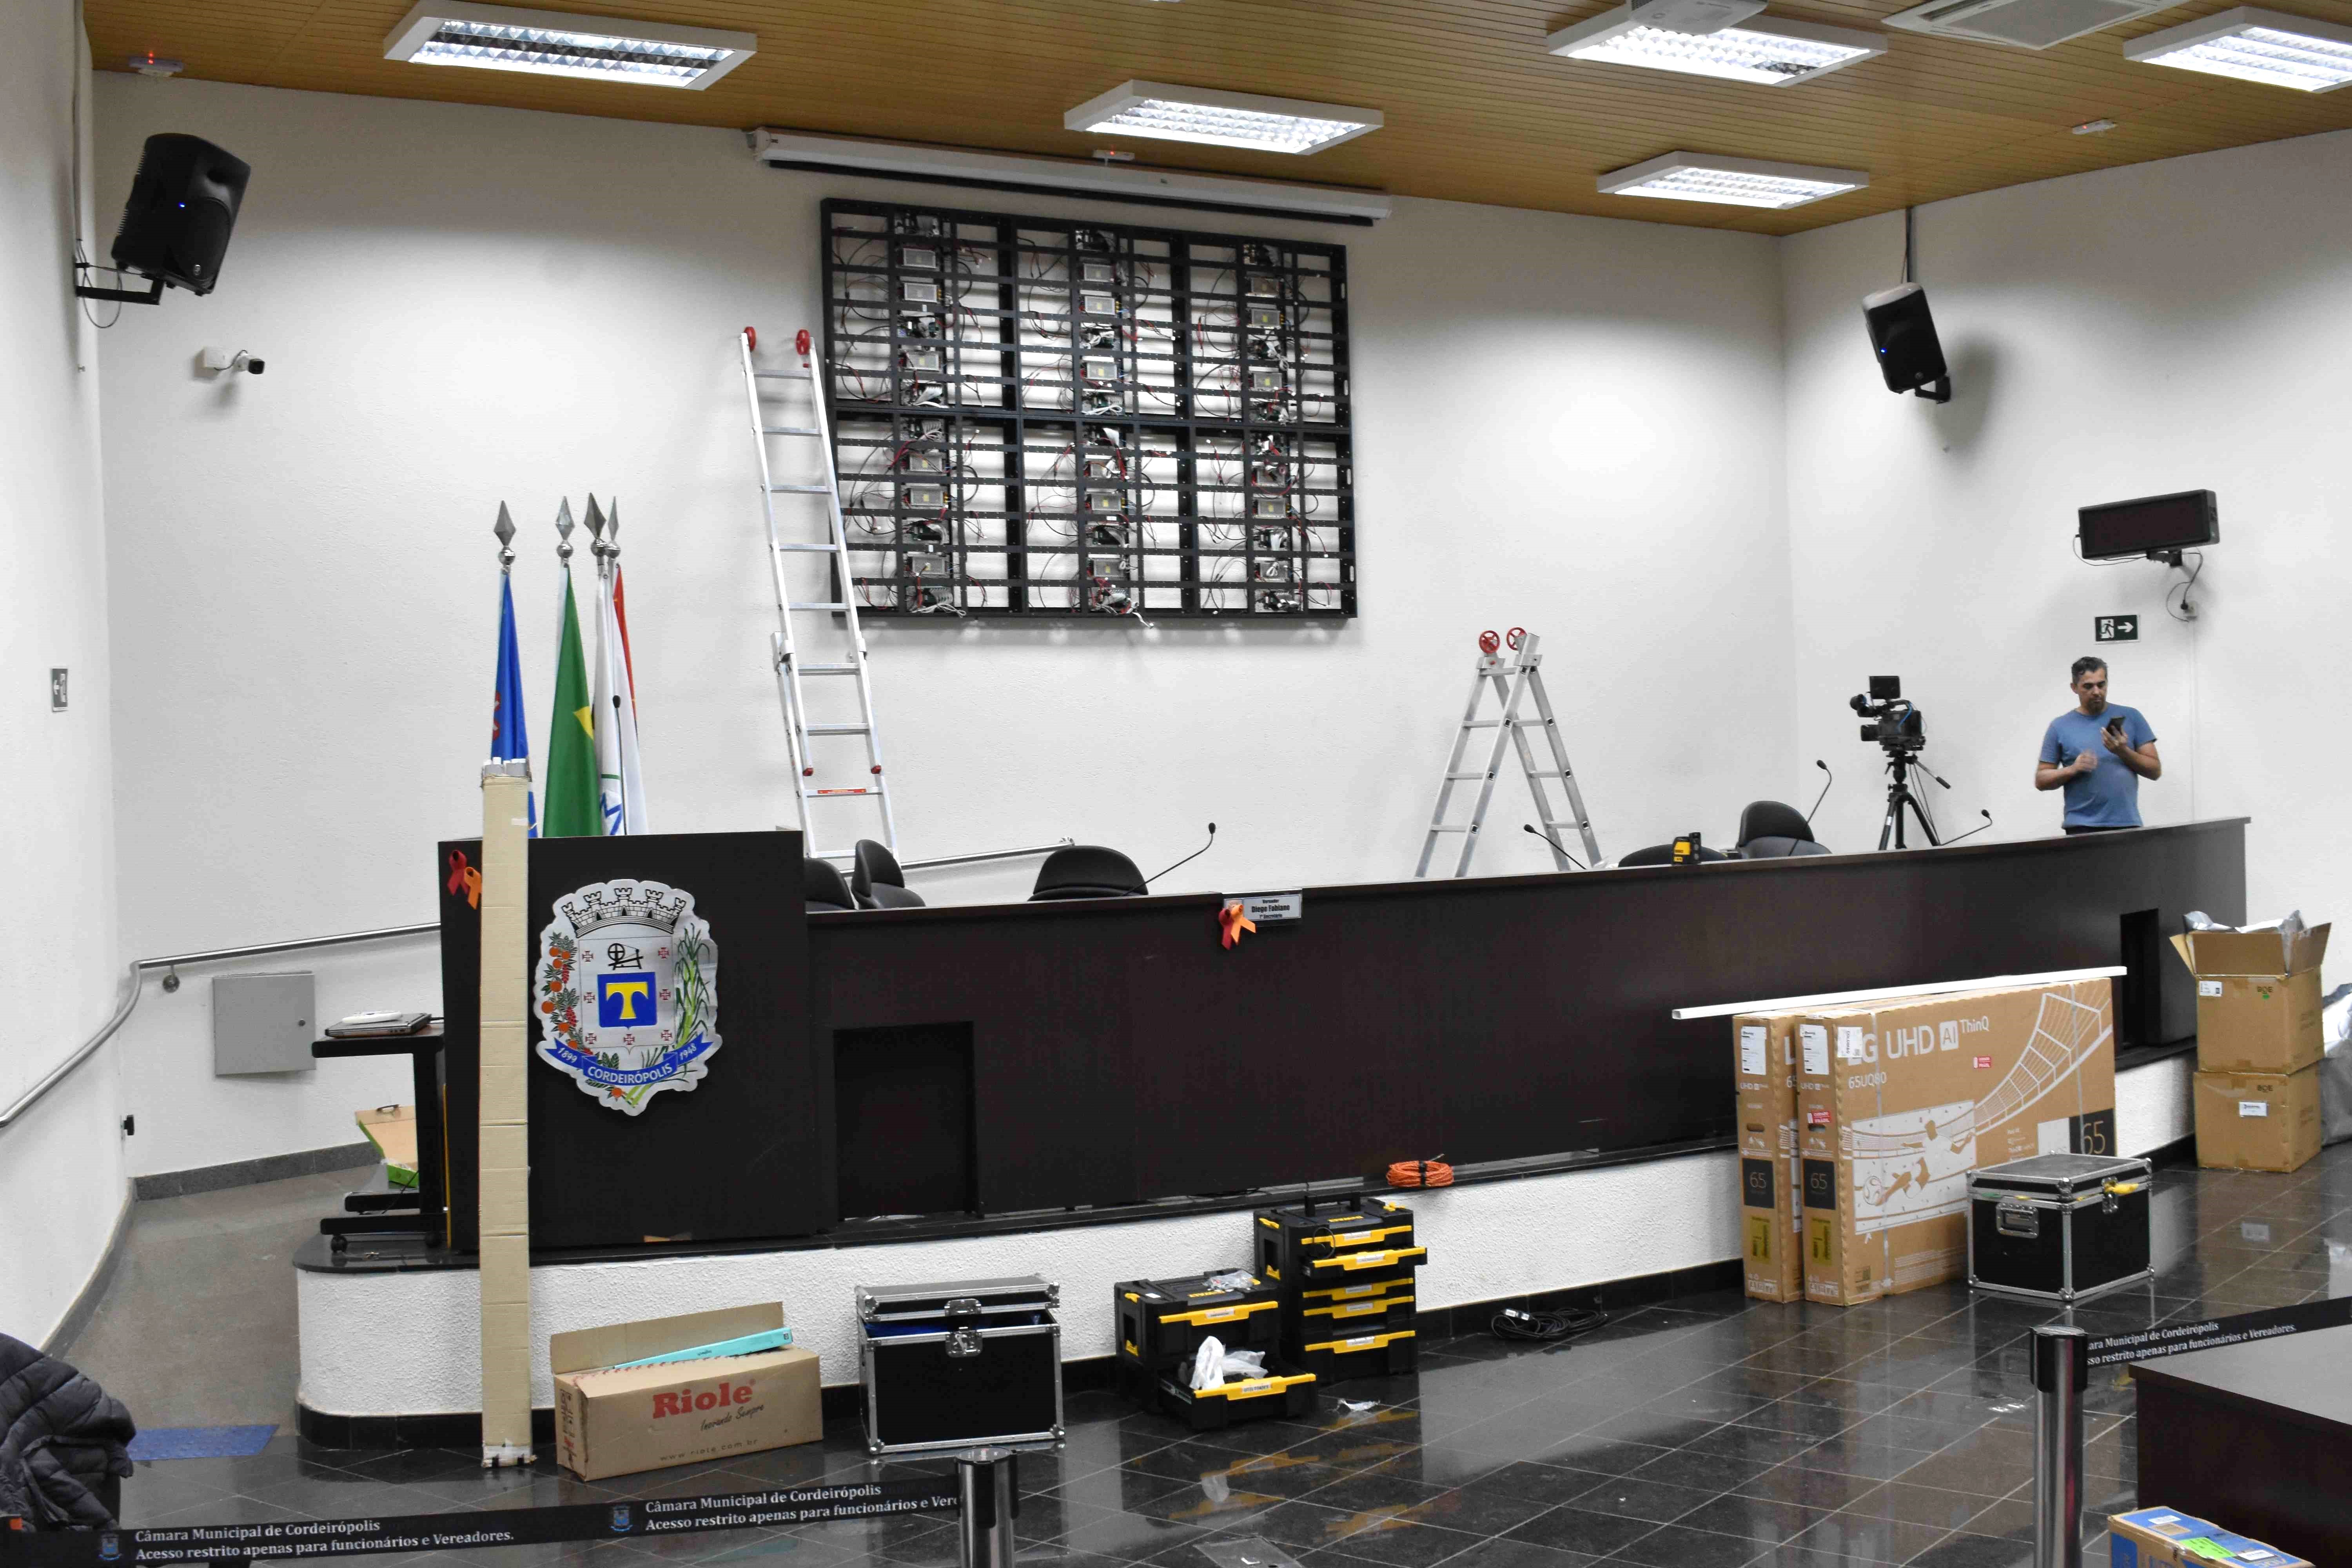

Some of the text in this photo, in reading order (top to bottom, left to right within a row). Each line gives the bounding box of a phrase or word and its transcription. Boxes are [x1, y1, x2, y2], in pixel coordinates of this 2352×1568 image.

[1847, 1033, 1878, 1066] G
[1886, 1025, 1935, 1059] UHD
[1960, 1016, 1989, 1033] ThinQ
[558, 1047, 577, 1063] 1899
[679, 1045, 697, 1060] 1948
[588, 1063, 672, 1083] CORDEIRÓPOLIS
[2082, 1121, 2105, 1155] 65
[1750, 1172, 1766, 1188] 65
[1810, 1173, 1827, 1189] 65
[2087, 1321, 2219, 1350] ara Municipal de Cordeirópolis
[2102, 1350, 2135, 1363] restrito
[2136, 1346, 2166, 1359] apenas
[2168, 1343, 2187, 1354] para
[2189, 1333, 2241, 1348] funcionários
[653, 1382, 753, 1419] Riole
[646, 1485, 881, 1513] Câmara Municipal de Cordeirópolis
[646, 1519, 692, 1530] Acesso
[695, 1514, 746, 1526] restrito
[749, 1510, 797, 1524] apenas
[800, 1507, 830, 1520] para
[834, 1500, 917, 1515] funcionários
[135, 1520, 380, 1542] Câmara Municipal de Cordeirópolis
[136, 1548, 183, 1560] Acesso
[187, 1545, 240, 1557] restrito
[243, 1544, 292, 1557] apenas
[296, 1542, 327, 1555] para
[332, 1536, 418, 1551] funcionários
[433, 1531, 514, 1544] Vereadores.
